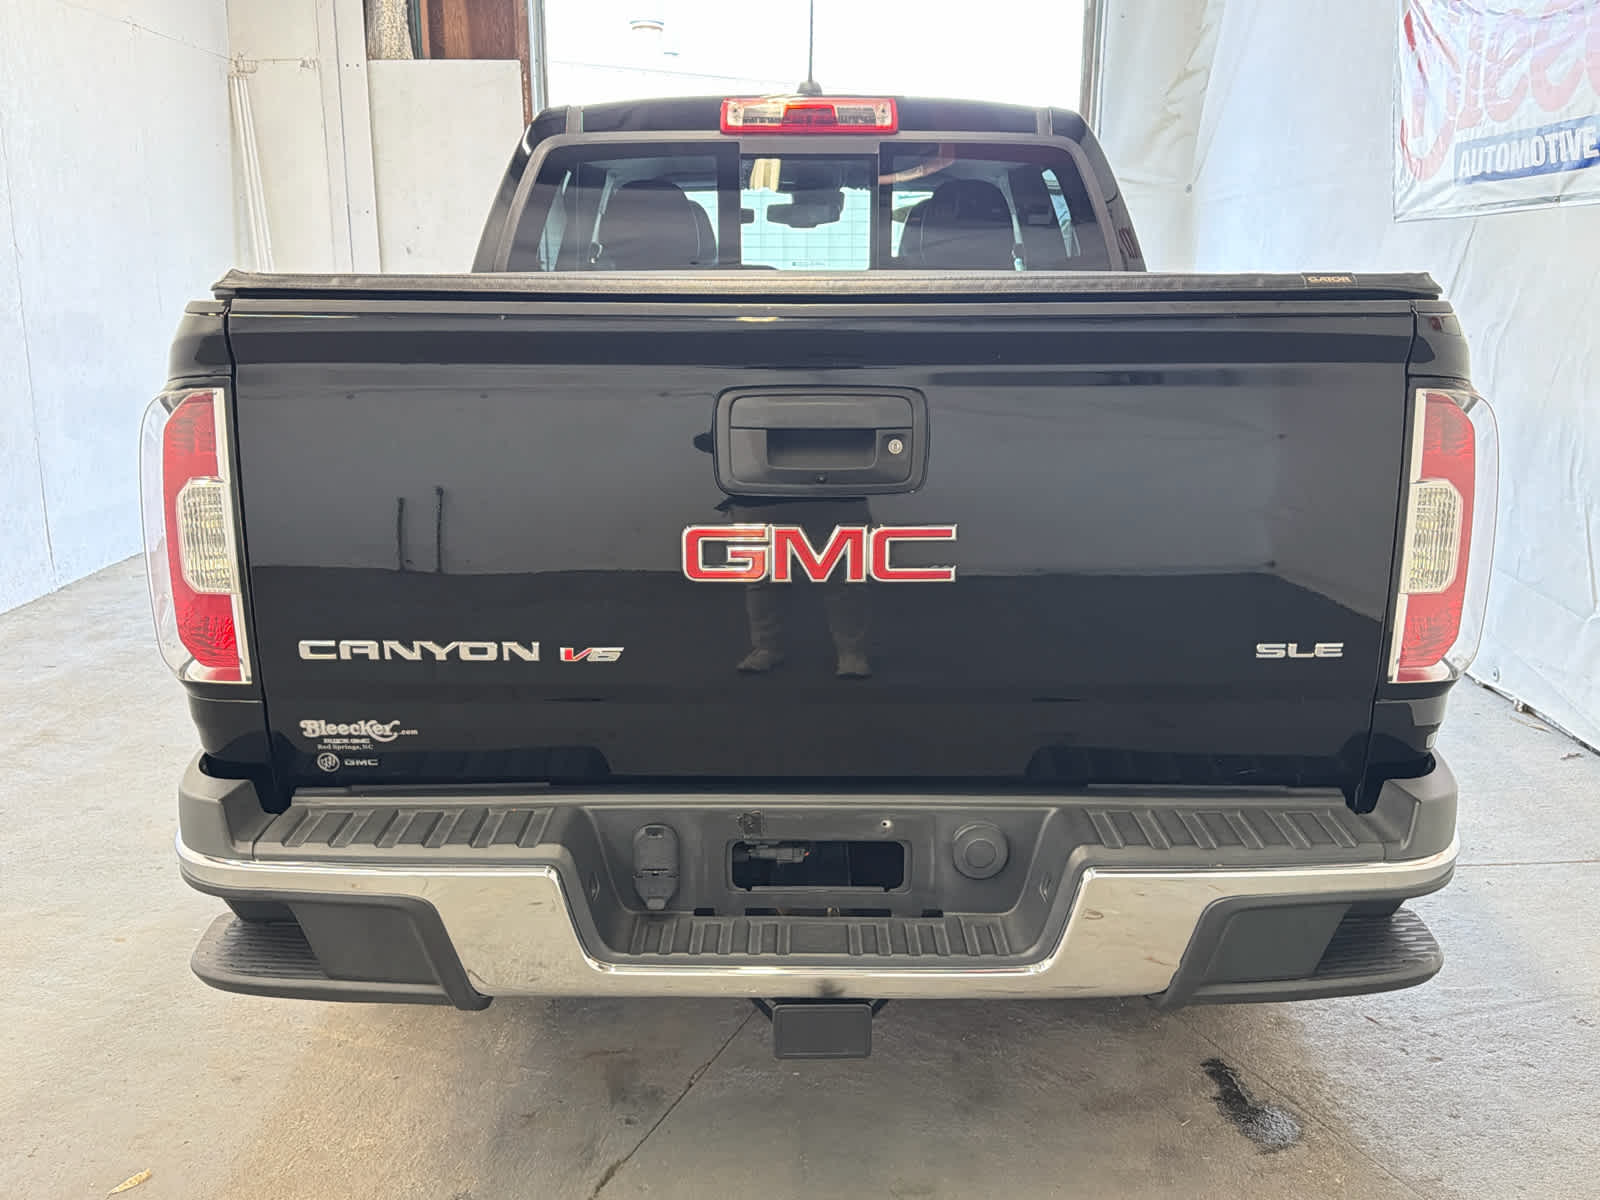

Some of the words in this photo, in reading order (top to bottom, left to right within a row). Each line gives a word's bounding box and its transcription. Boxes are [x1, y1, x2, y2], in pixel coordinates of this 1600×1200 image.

[1459, 127, 1600, 177] AUTOMOTIVE
[681, 523, 958, 583] GMC
[298, 640, 540, 661] CANYON
[559, 646, 624, 661] V6
[1255, 642, 1344, 658] SLE
